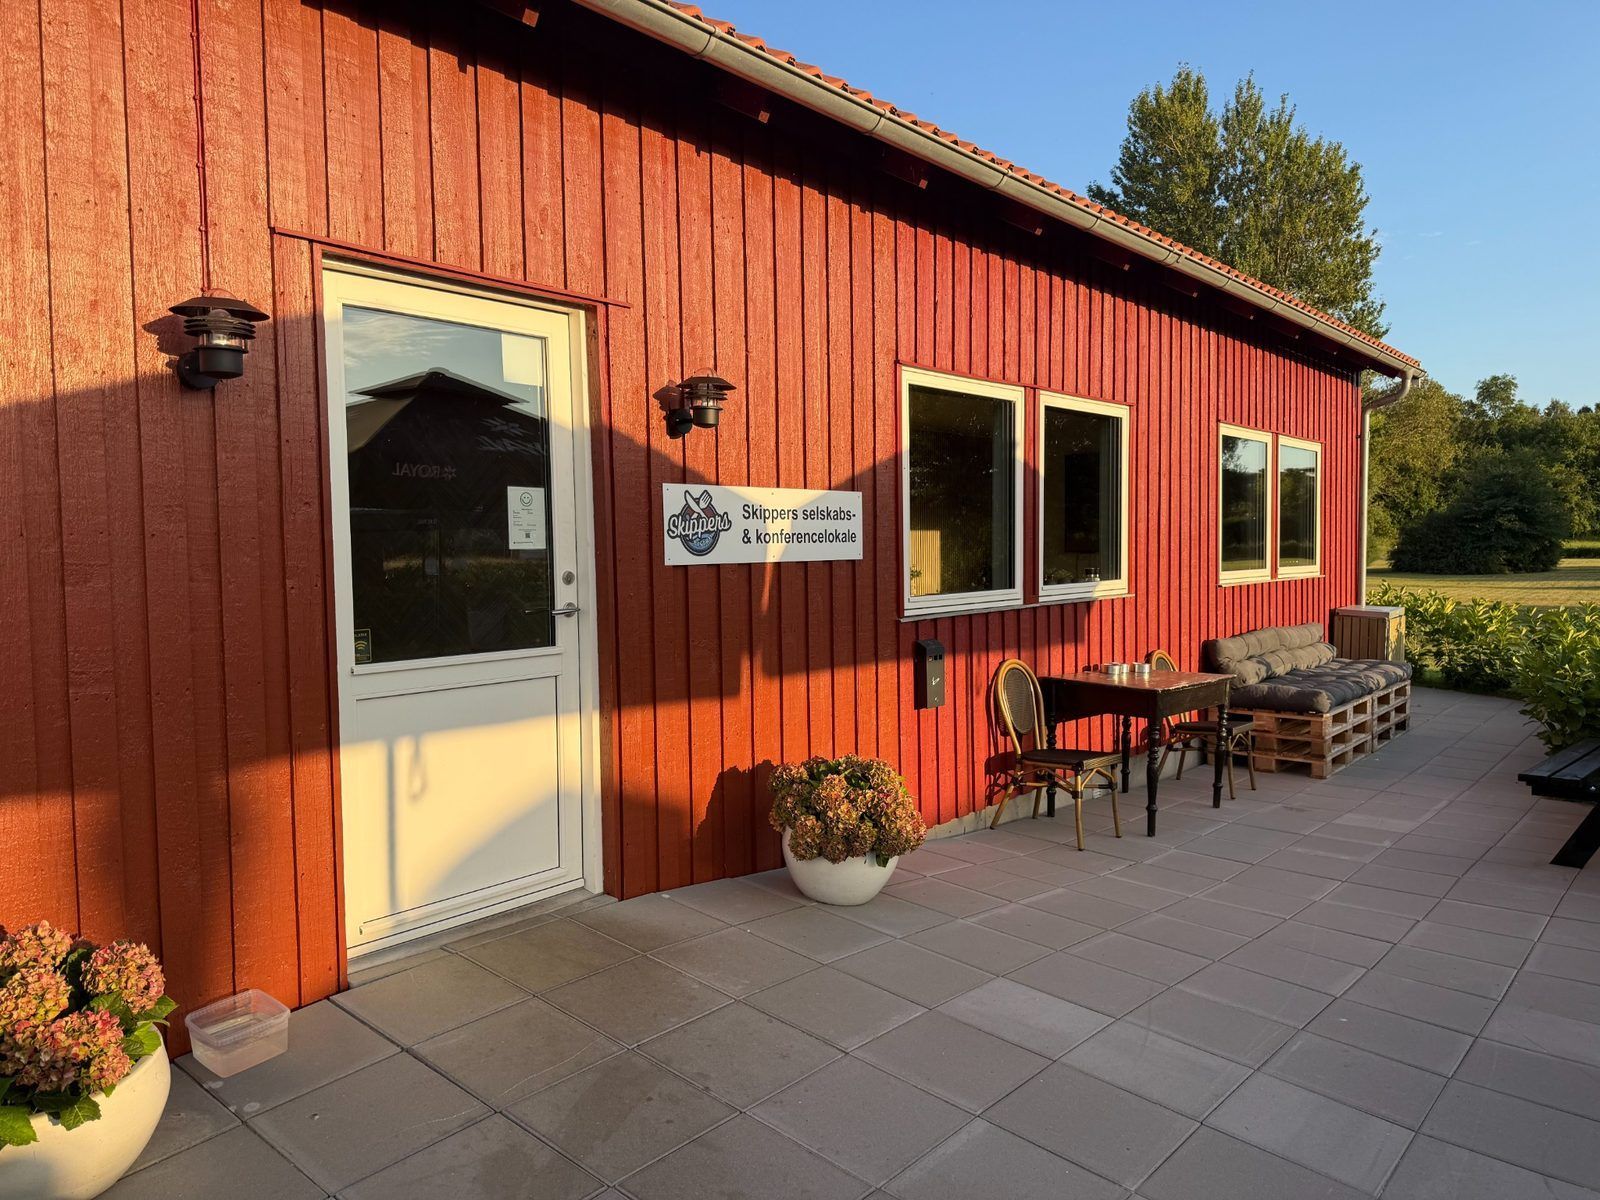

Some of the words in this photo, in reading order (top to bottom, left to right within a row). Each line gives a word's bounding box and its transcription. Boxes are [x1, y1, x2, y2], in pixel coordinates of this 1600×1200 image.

[742, 503, 799, 524] Skippers
[802, 506, 856, 521] selskabs-
[667, 510, 731, 539] Skippers
[741, 531, 752, 545] &
[755, 528, 857, 544] konferencelokale
